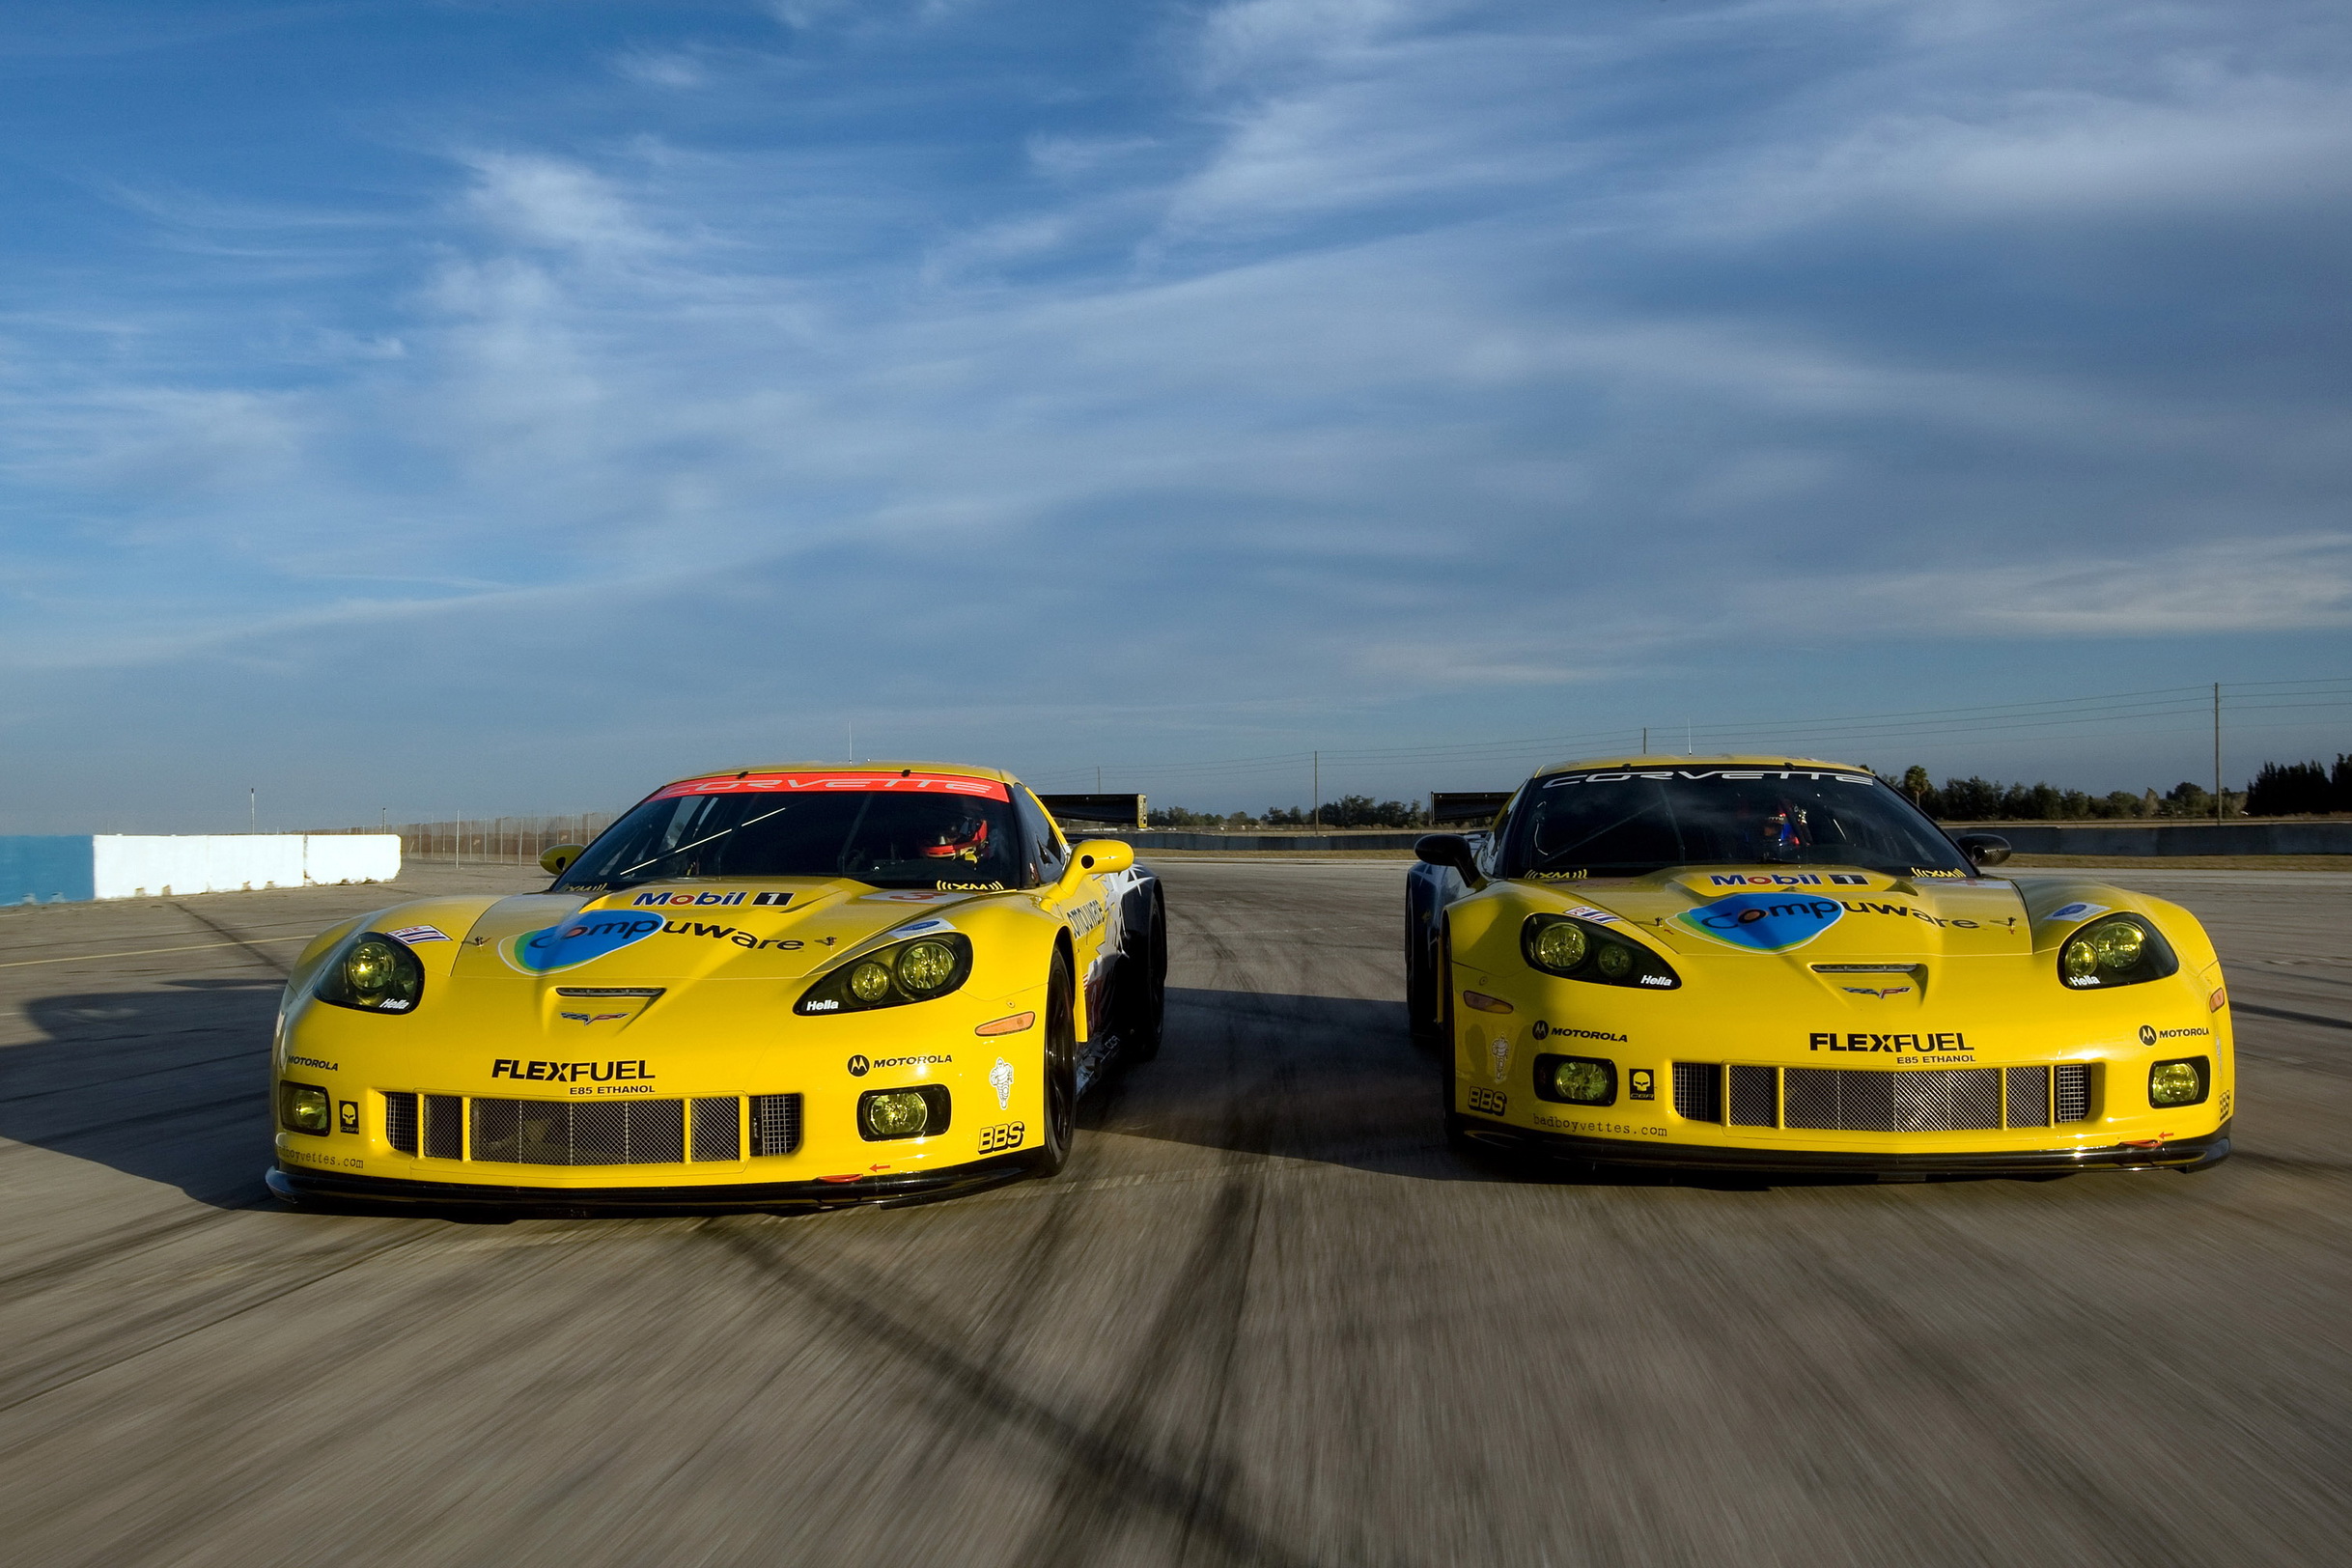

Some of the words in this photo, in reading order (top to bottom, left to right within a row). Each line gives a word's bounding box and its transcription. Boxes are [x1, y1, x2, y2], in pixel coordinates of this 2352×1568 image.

[659, 778, 993, 797] CORVETTE
[1543, 770, 1874, 789] CORVETTE
[1709, 874, 1822, 885] Mobil
[632, 892, 747, 906] Mobil
[1701, 899, 1980, 930] Compuware
[529, 918, 805, 951] Compuware
[1639, 974, 1673, 987] Hella
[2069, 974, 2101, 987] Hella
[379, 997, 410, 1010] Hella
[806, 999, 839, 1011] Hella
[1551, 1027, 1629, 1043] MOTOROLA
[2159, 1026, 2210, 1039] MOTOROLA
[1808, 1032, 1975, 1053] FLEXFUEL
[288, 1055, 339, 1071] MOTOROLA
[873, 1054, 953, 1068] MOTOROLA
[1896, 1055, 1919, 1064] E85
[1922, 1054, 1977, 1063] ETHANOL
[491, 1058, 656, 1082] FLEXFUEL
[569, 1086, 593, 1095] E85
[597, 1084, 656, 1094] ETHANOL
[1468, 1085, 1508, 1117] BBS
[1532, 1112, 1668, 1137] badboyvettes.com
[977, 1120, 1025, 1156] BBS
